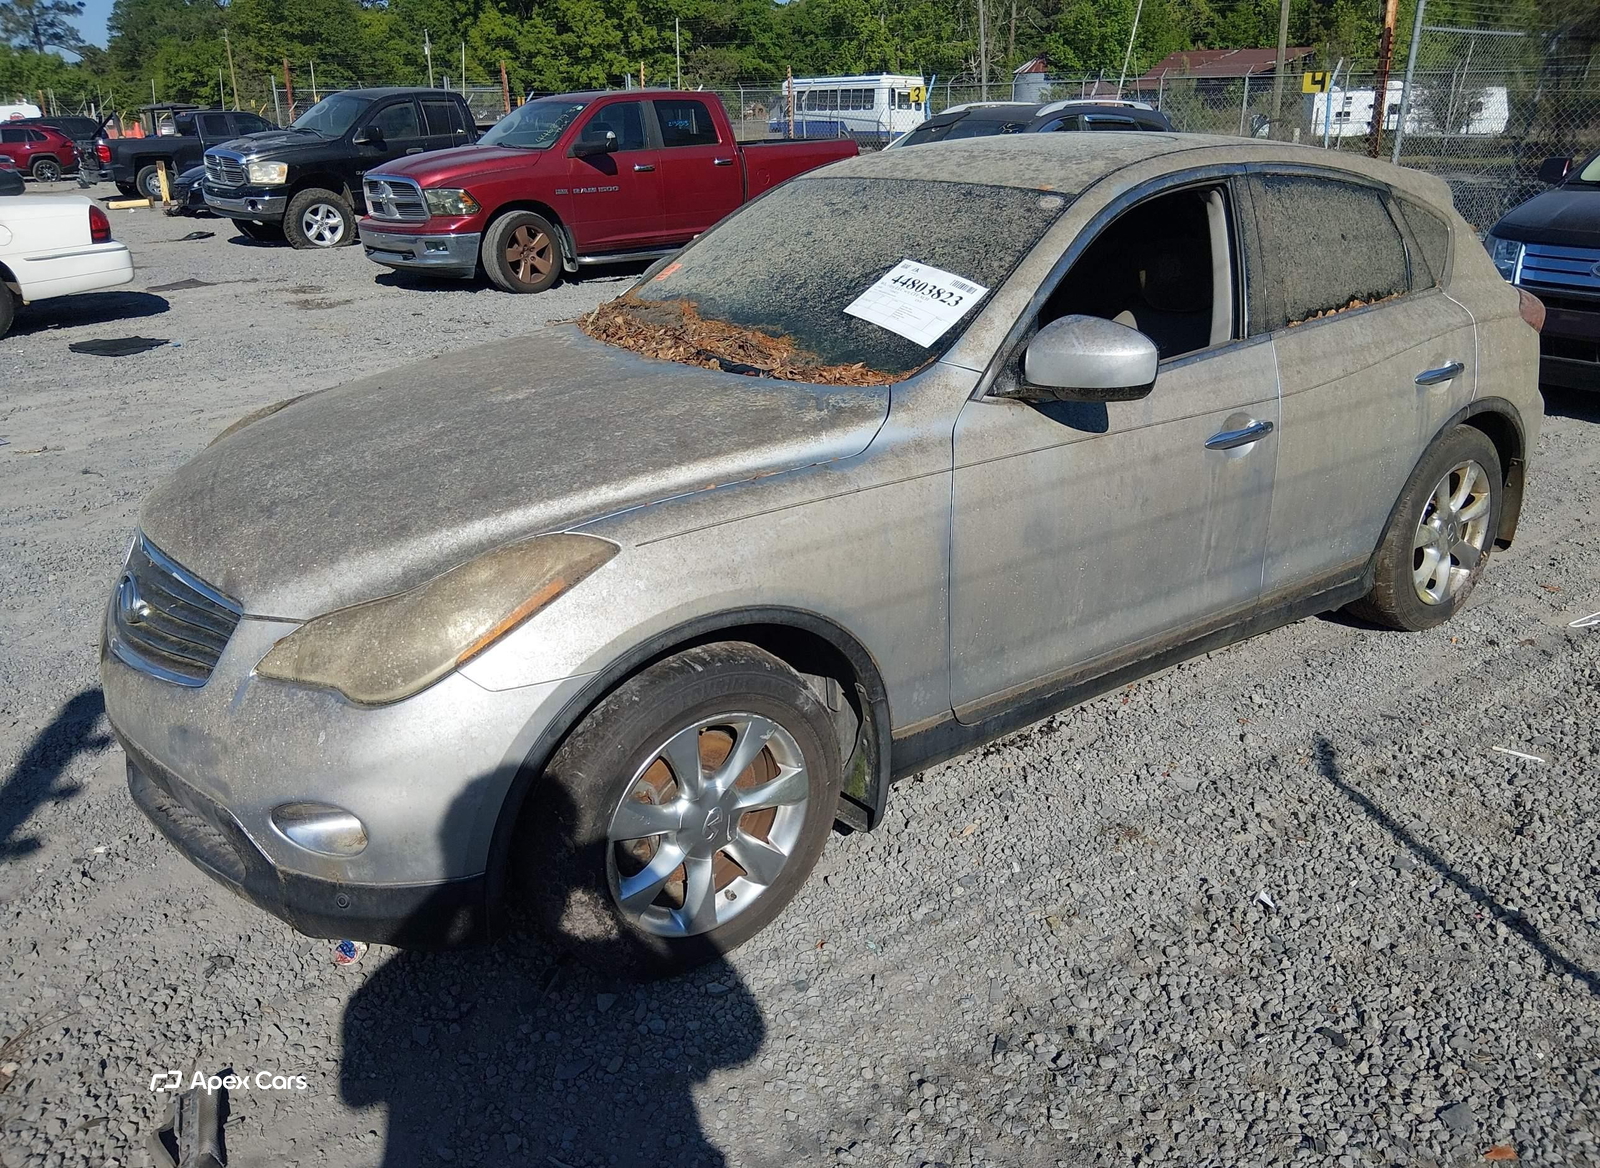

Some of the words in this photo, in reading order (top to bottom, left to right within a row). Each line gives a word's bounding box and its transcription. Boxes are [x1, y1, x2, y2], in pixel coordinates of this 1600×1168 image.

[1311, 71, 1327, 92] 4
[912, 86, 921, 102] 3
[891, 275, 964, 307] 44803823
